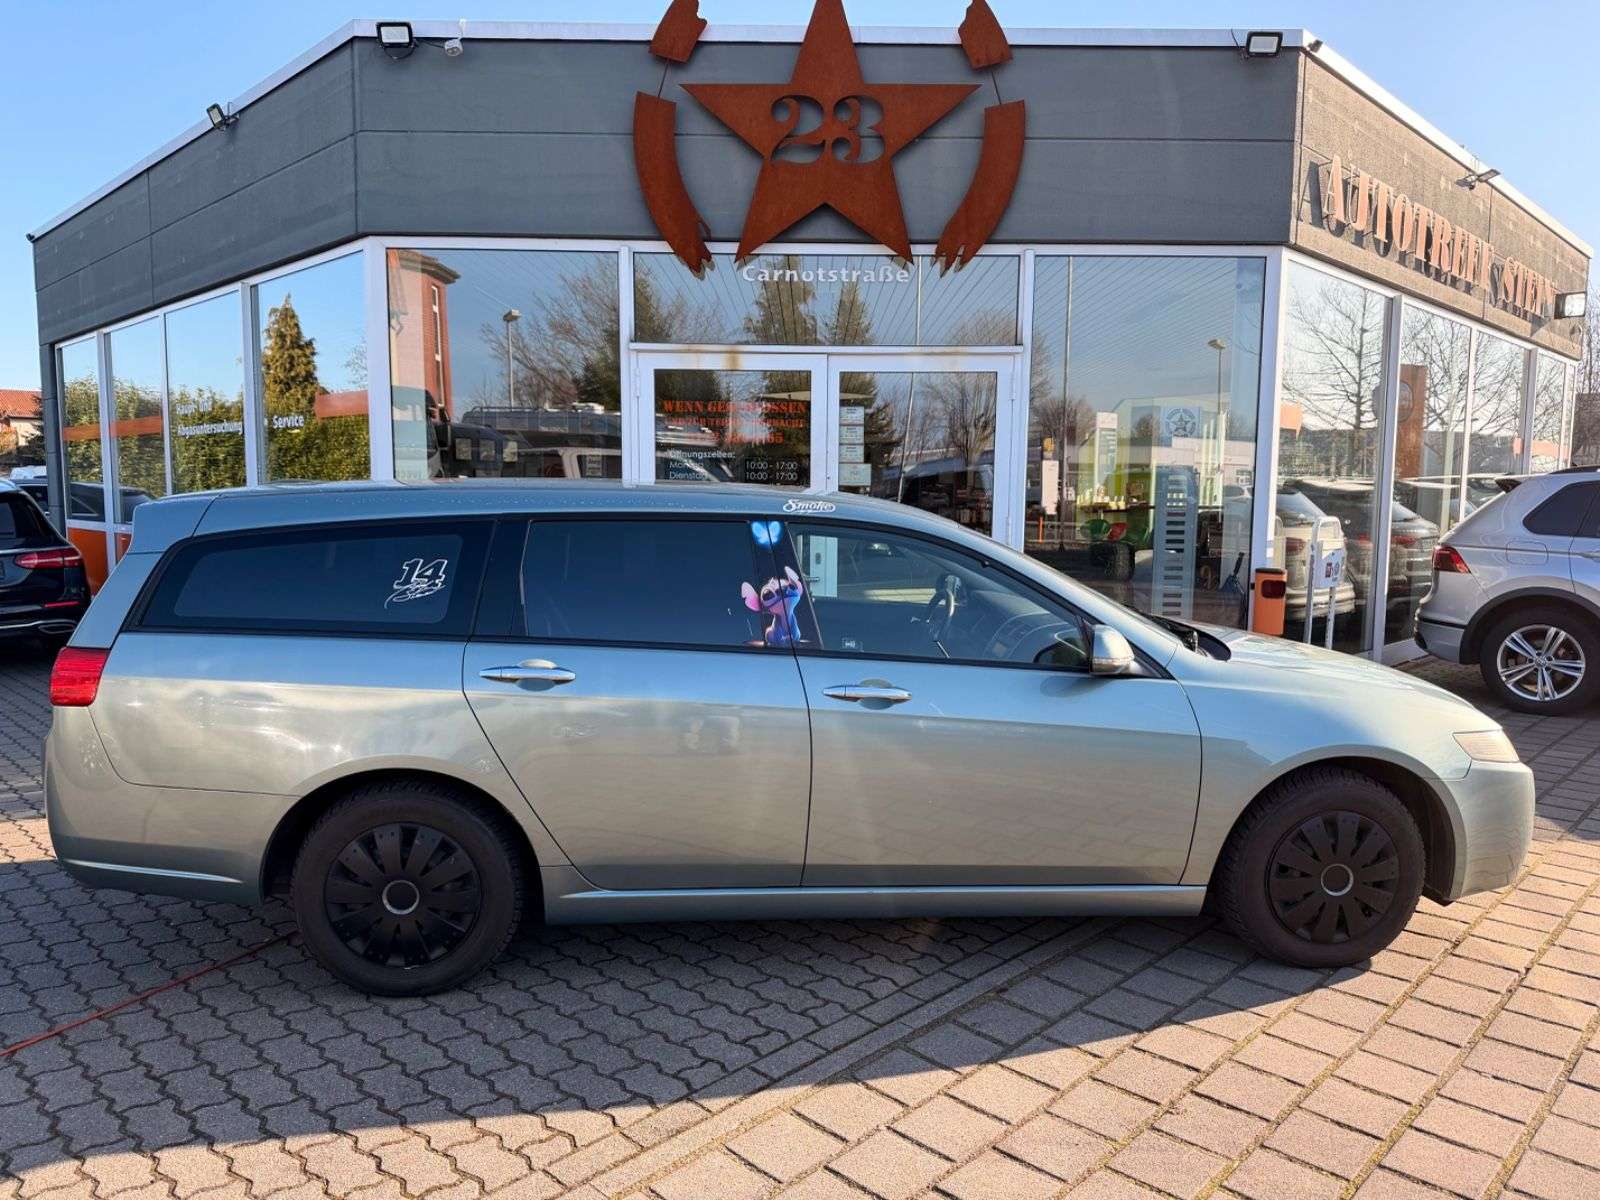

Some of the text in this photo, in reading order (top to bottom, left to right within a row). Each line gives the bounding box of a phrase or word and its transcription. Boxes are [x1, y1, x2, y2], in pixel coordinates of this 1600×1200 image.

[769, 94, 886, 164] 23
[741, 264, 911, 283] Carnotstraße
[664, 400, 703, 412] WENN
[272, 415, 305, 429] Service
[746, 461, 769, 471] 10:00
[775, 461, 799, 471] 17:00
[746, 472, 769, 481] 10:00
[775, 472, 799, 481] 17:00
[393, 558, 448, 590] 14
